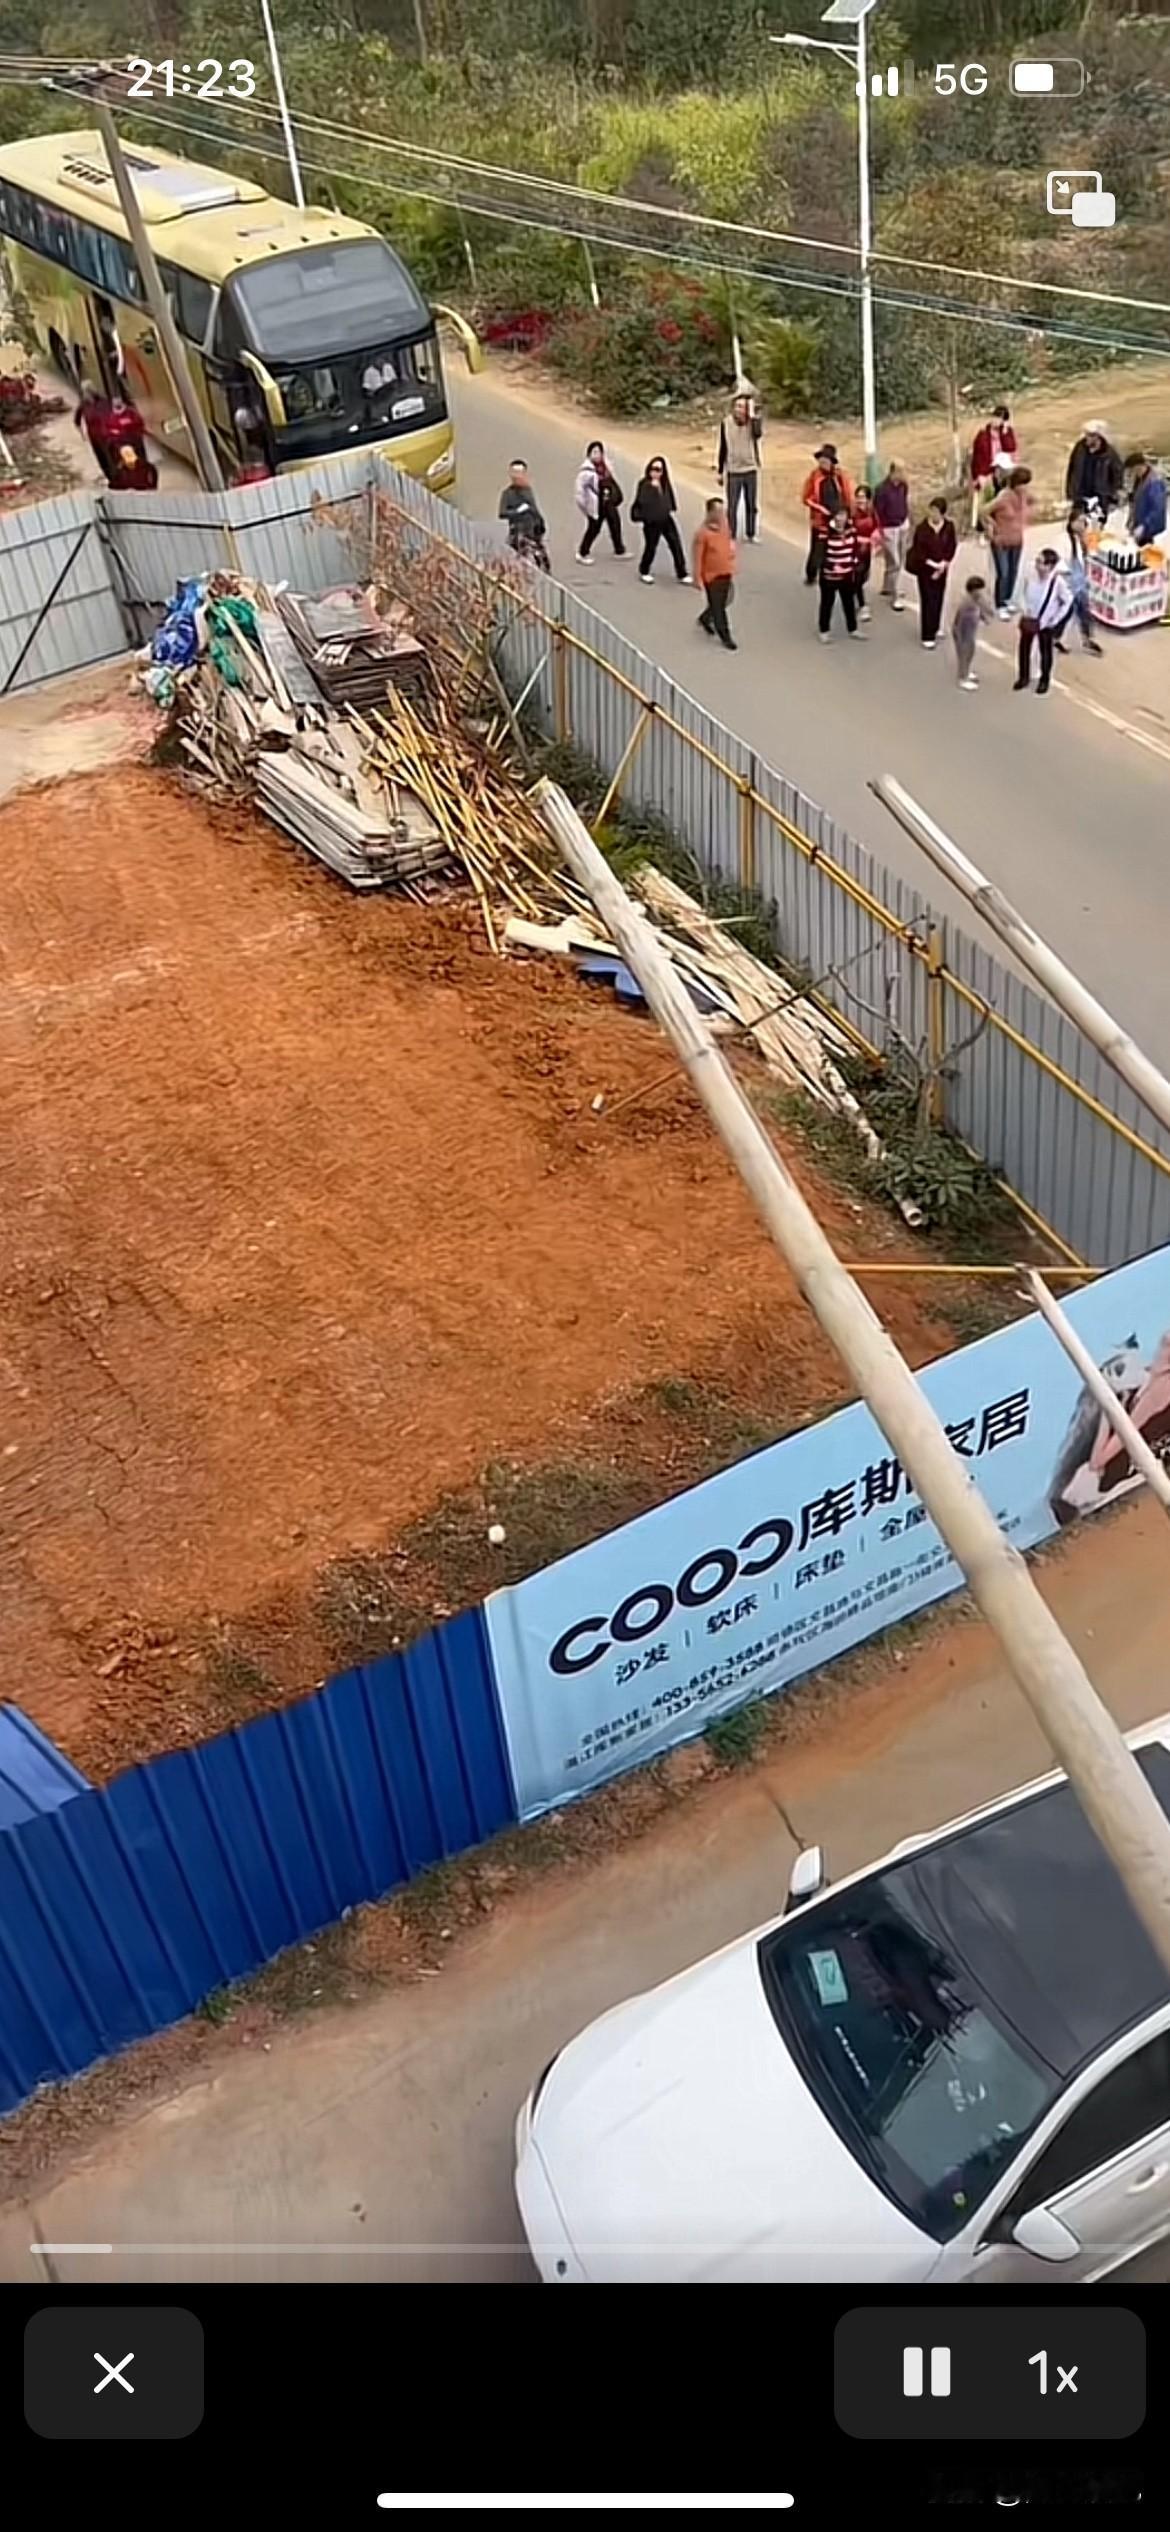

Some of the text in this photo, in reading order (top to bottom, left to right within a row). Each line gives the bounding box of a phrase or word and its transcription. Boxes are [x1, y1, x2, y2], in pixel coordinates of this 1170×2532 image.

[614, 1643, 669, 1686] 沙发
[706, 1594, 758, 1635] 软床
[795, 1550, 845, 1588] 床垫
